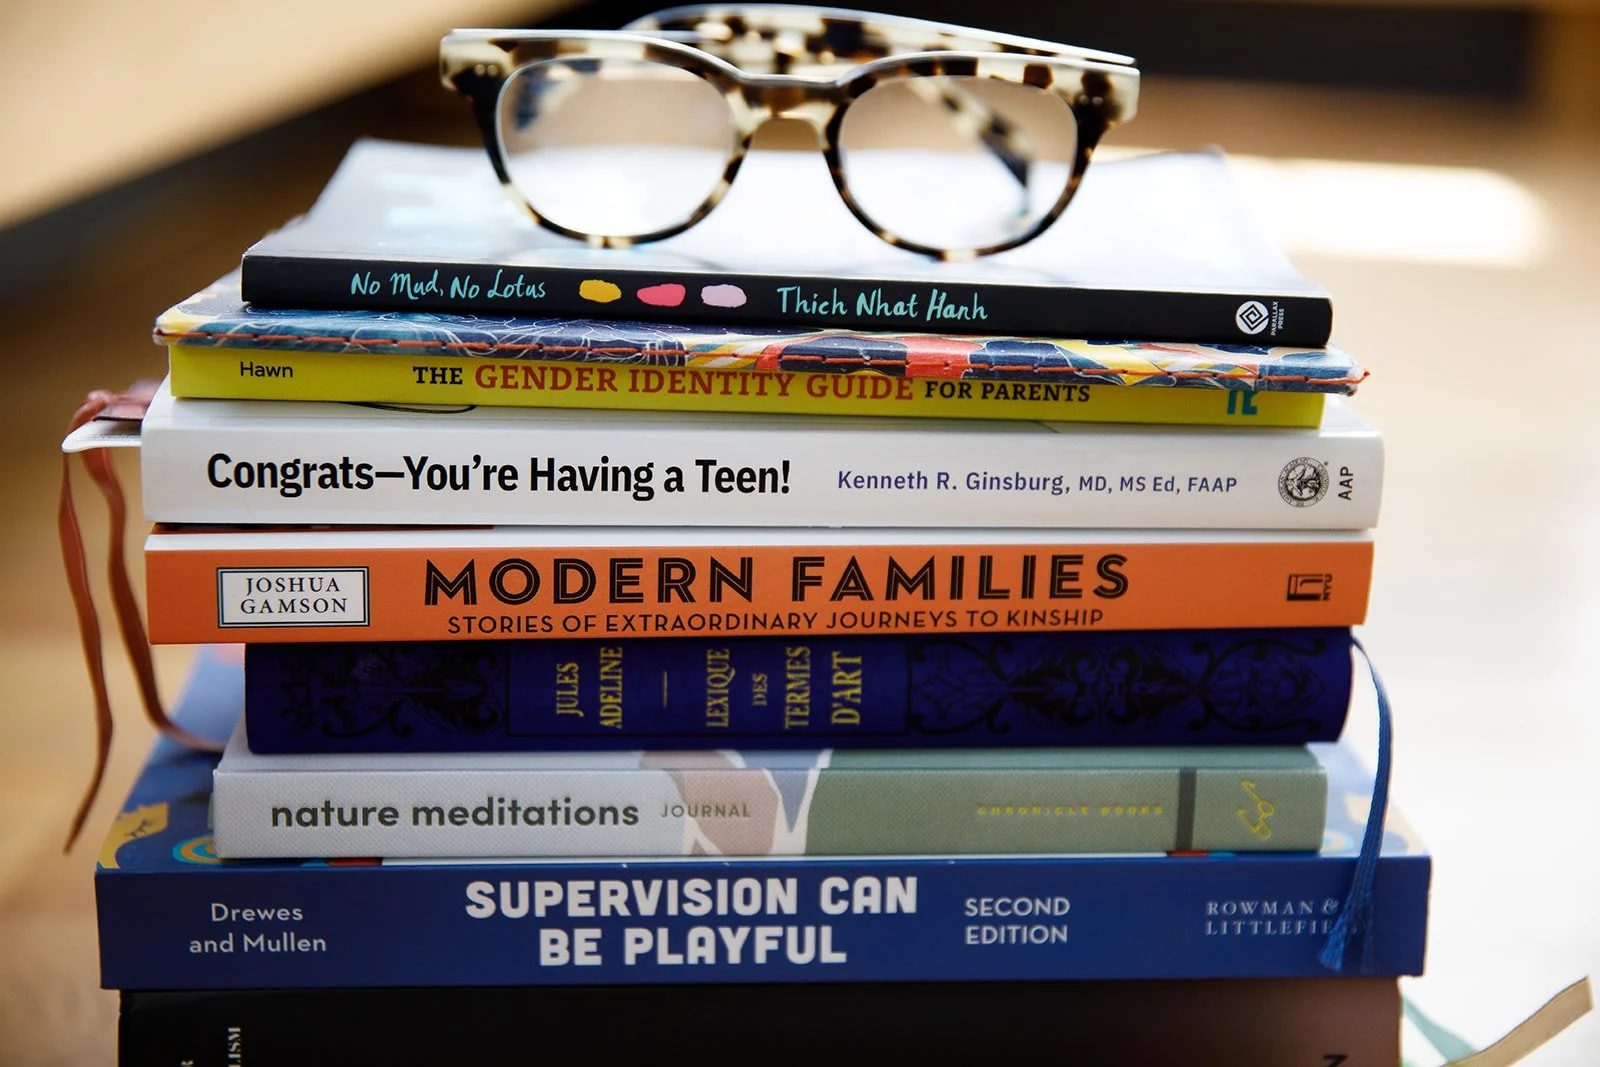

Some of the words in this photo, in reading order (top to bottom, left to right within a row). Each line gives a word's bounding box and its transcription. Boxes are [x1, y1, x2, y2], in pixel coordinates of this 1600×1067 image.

[351, 271, 381, 295] No
[389, 268, 444, 300] Mud,
[450, 275, 480, 299] No
[487, 268, 546, 298] Lotus
[776, 285, 848, 315] Thich
[856, 287, 919, 318] Nhat
[926, 288, 989, 322] Hanh
[1270, 301, 1279, 336] PARALLAX
[1277, 308, 1285, 330] PRESS
[240, 361, 294, 378] Hawn
[412, 366, 463, 385] THE
[475, 364, 618, 392] GENDER
[628, 368, 796, 397] IDENTITY
[806, 373, 914, 400] GUIDE
[924, 380, 973, 399] FOR
[981, 381, 1091, 402] PARENTS
[530, 455, 655, 502] Having
[663, 466, 685, 493] a
[694, 459, 791, 493] Teen!
[838, 470, 928, 490] Kenneth
[936, 471, 957, 490] R.
[966, 471, 1070, 496] Ginsburg,
[1079, 475, 1113, 494] MD,
[1119, 476, 1146, 492] MS
[1152, 475, 1181, 495] Ed,
[1187, 476, 1238, 493] FAAP
[1337, 466, 1354, 501] AAP
[246, 576, 342, 594] JOSHUA
[424, 556, 754, 606] MODERN
[791, 553, 1130, 602] FAMILIES
[1321, 573, 1333, 601] NYU
[240, 597, 348, 615] GAMSON
[447, 615, 554, 634] STORIES
[562, 614, 597, 633] OF
[606, 611, 819, 633] EXTRAORDINARY
[826, 609, 958, 630] JOURNEYS
[966, 609, 999, 628] TO
[1006, 608, 1104, 627] KINSHIP
[556, 662, 585, 718] JULES
[599, 647, 623, 729] ADELINE
[706, 648, 736, 727] LEXIQUE
[752, 672, 769, 707] DES
[784, 646, 811, 729] TERMES
[271, 800, 400, 828] nature
[412, 796, 639, 827] meditations
[661, 802, 751, 819] JOURNAL
[977, 805, 1089, 816] CHRONICLE
[1101, 805, 1164, 815] BOOKS
[211, 902, 304, 922] Drewes
[465, 877, 797, 920] SUPERVISION
[819, 875, 918, 916] CAN
[965, 897, 1071, 917] SECOND
[1206, 900, 1314, 916] ROWMAN
[1322, 898, 1339, 915] &
[189, 932, 234, 954] and
[243, 931, 326, 953] Mullen
[539, 928, 603, 966] BE
[624, 925, 847, 965] PLAYFUL
[966, 925, 1068, 945] EDITION
